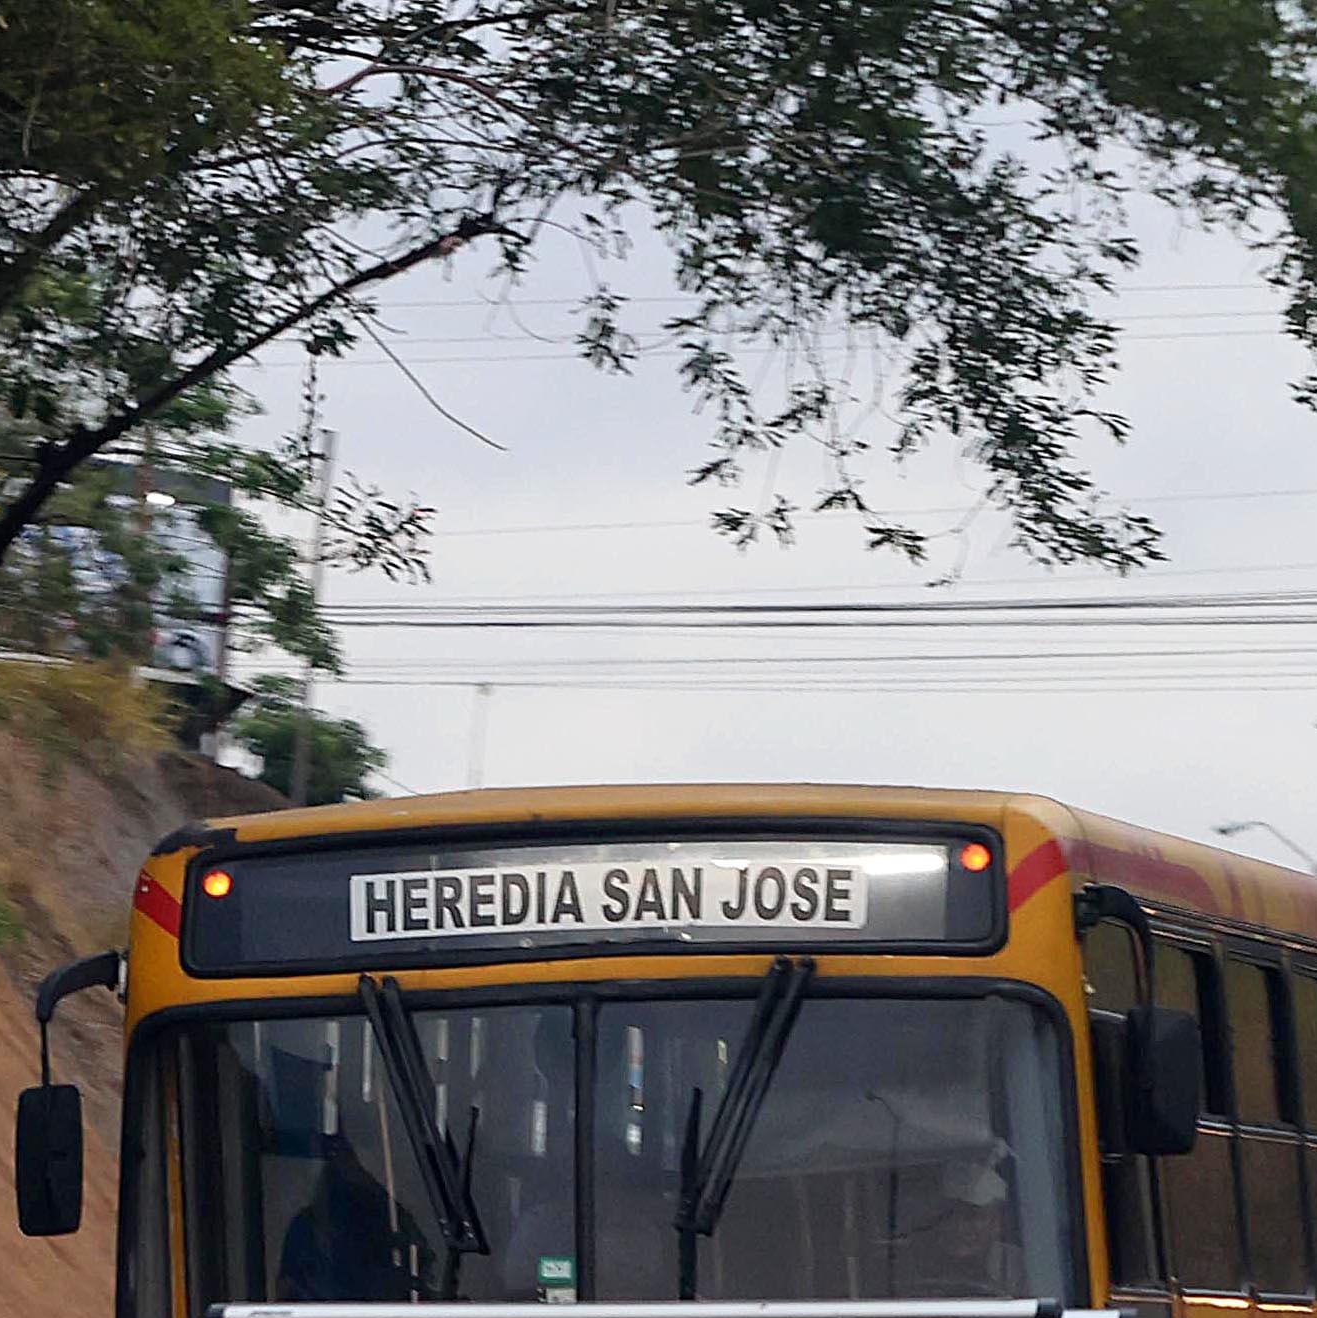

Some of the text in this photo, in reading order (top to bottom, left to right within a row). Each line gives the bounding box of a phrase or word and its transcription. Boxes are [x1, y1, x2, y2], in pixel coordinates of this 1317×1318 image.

[366, 866, 852, 934] HEREDIA SAN JOSE
